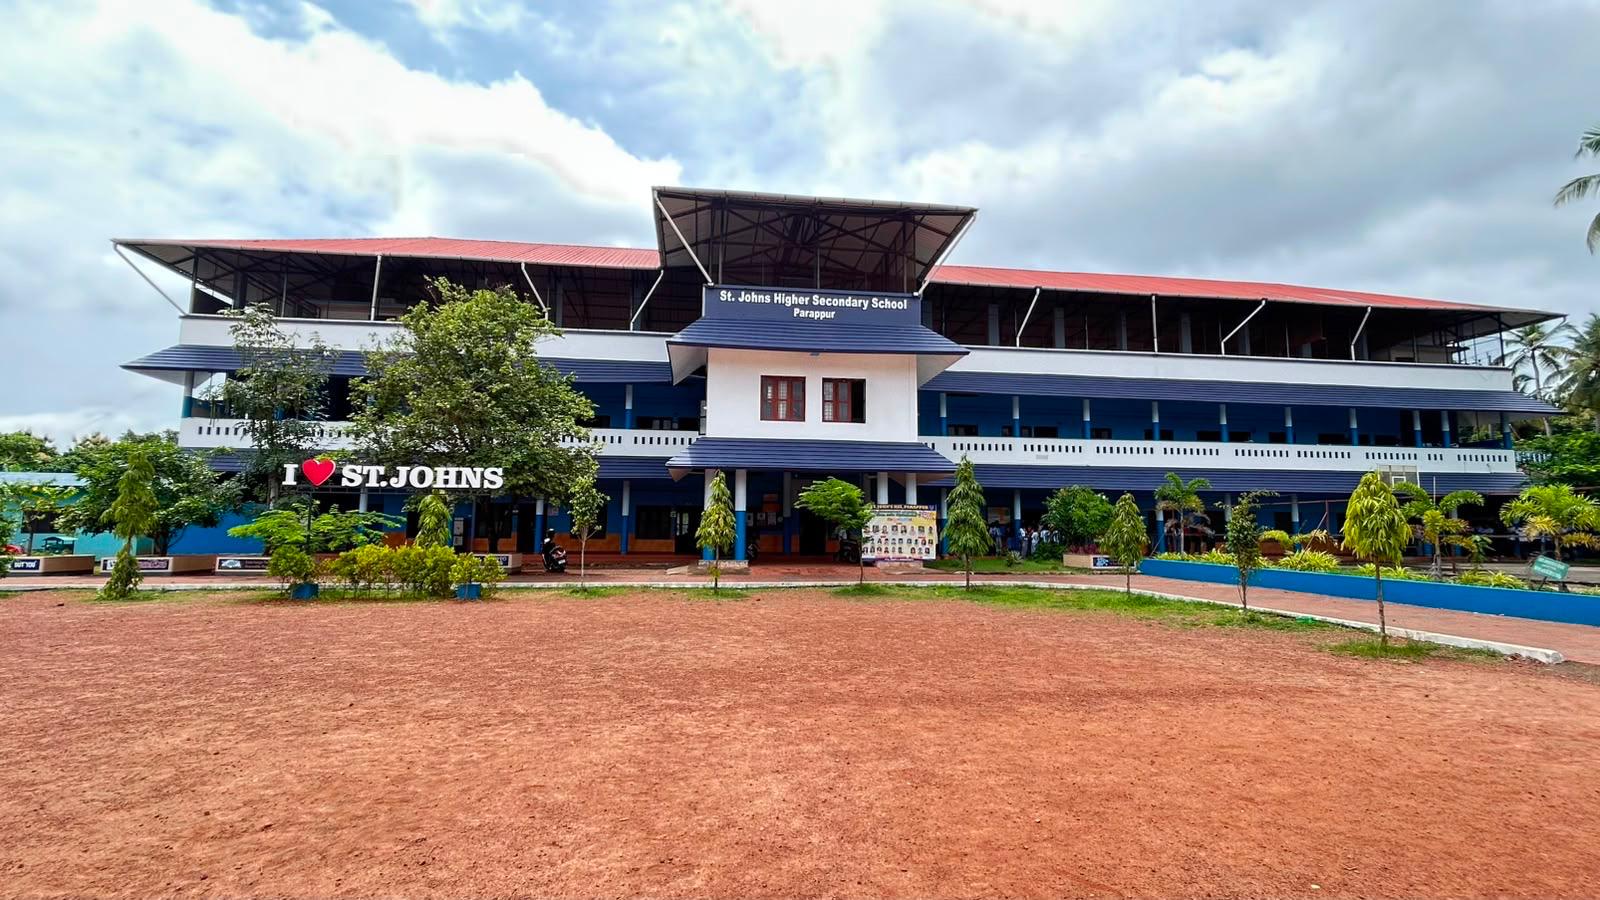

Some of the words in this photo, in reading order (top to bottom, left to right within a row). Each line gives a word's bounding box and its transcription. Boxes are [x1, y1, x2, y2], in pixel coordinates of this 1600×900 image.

[719, 290, 735, 302] St.
[738, 291, 771, 304] Johns
[774, 293, 809, 308] Higher
[812, 294, 869, 310] Secondary
[871, 298, 908, 310] School
[793, 307, 835, 320] Parappur
[281, 463, 299, 486] I
[341, 465, 504, 489] ST.JOHNS
